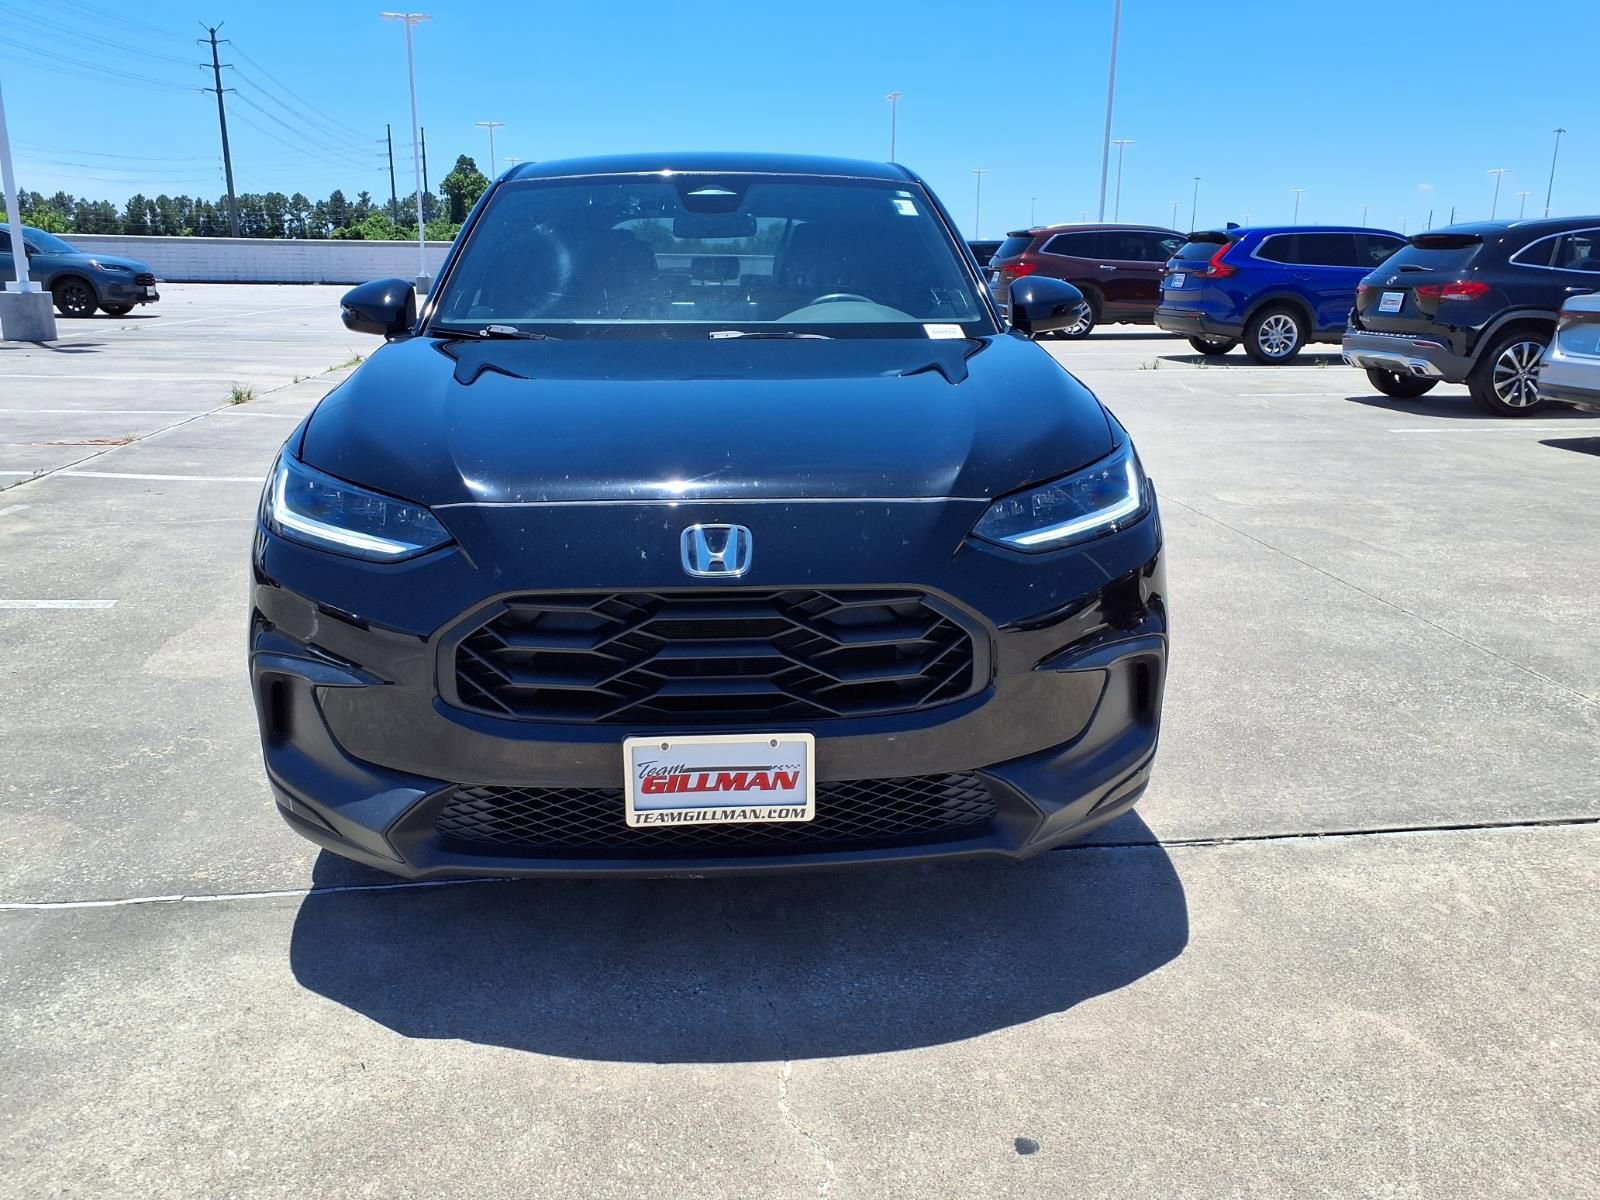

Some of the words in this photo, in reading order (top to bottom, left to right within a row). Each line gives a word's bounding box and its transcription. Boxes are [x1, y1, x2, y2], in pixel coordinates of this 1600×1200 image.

[637, 760, 686, 779] Team
[641, 770, 800, 795] GILLMAN
[634, 808, 807, 825] TEAMGILLMAN.COM
